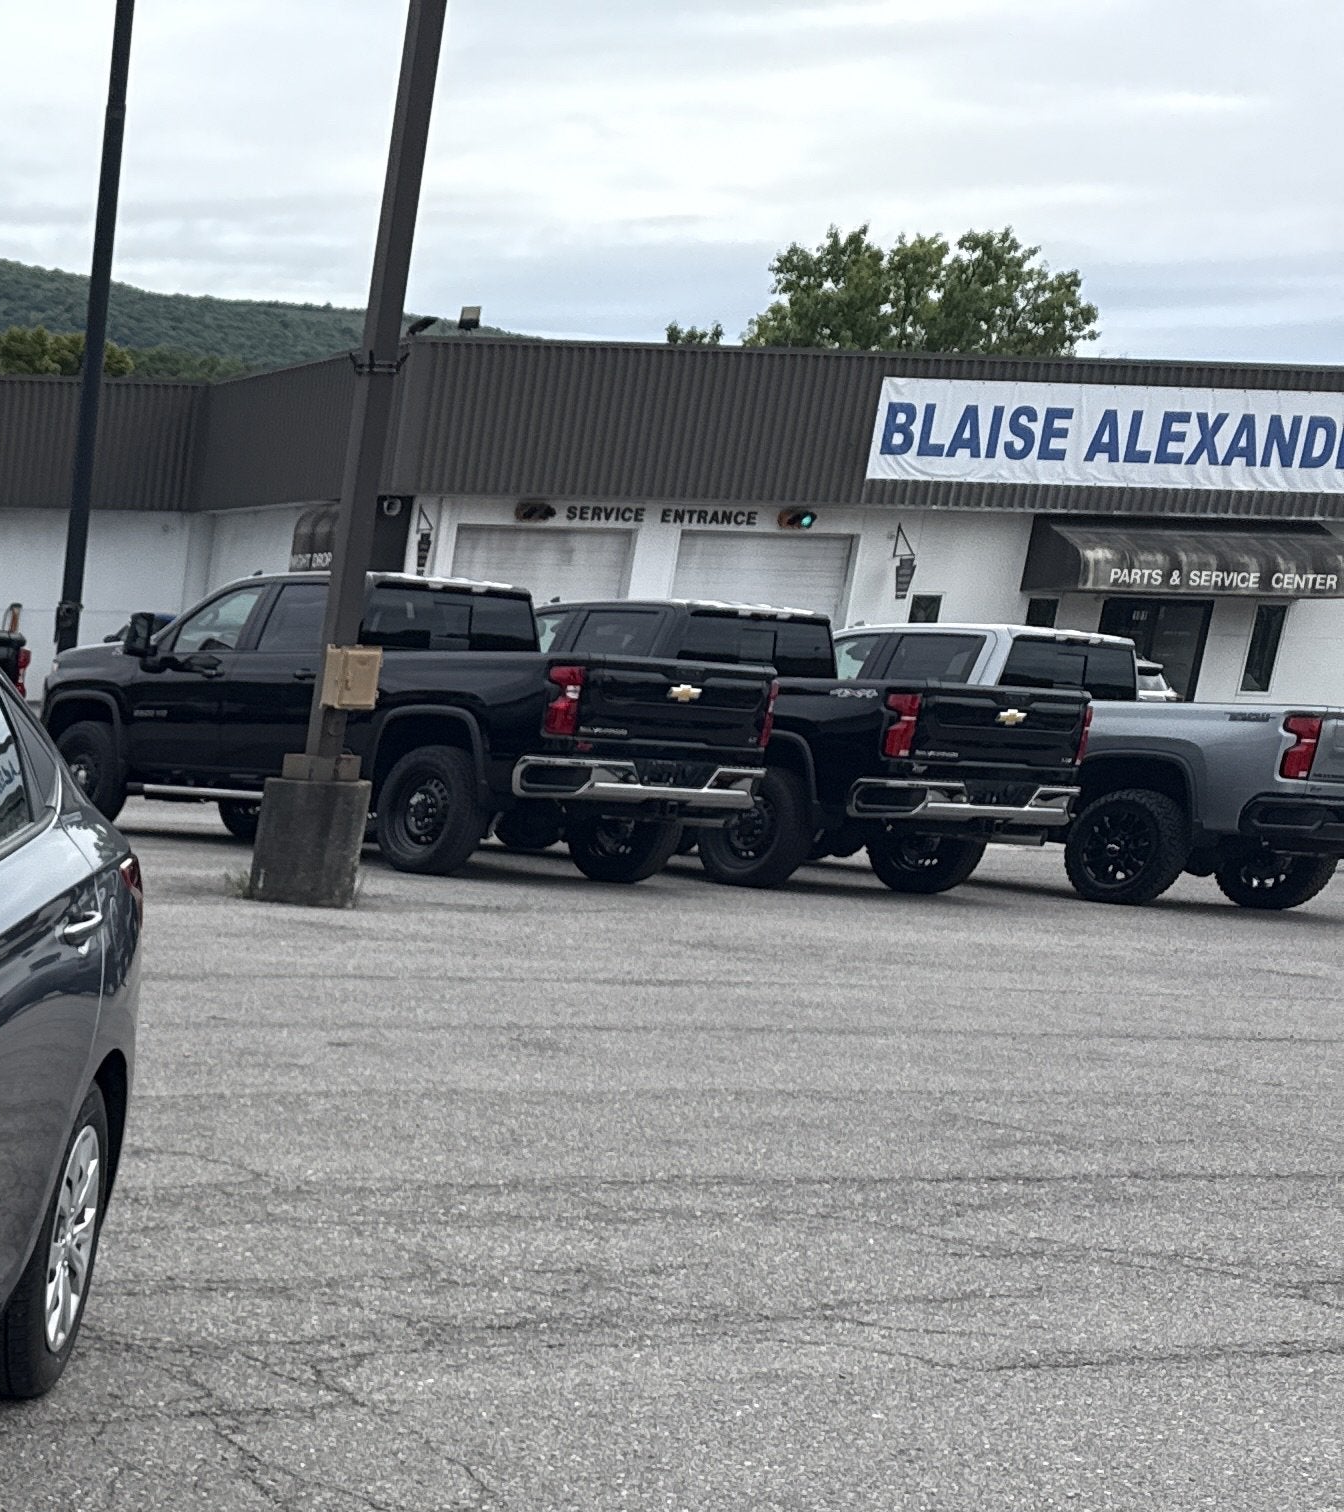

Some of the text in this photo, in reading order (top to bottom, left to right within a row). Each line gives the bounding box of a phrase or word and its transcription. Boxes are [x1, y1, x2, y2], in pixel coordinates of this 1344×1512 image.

[879, 401, 1344, 470] BLAISE ALEXAND
[566, 505, 758, 526] SERVICE ENTRANCE
[1109, 568, 1338, 589] PARTS & SERVICE CENTER
